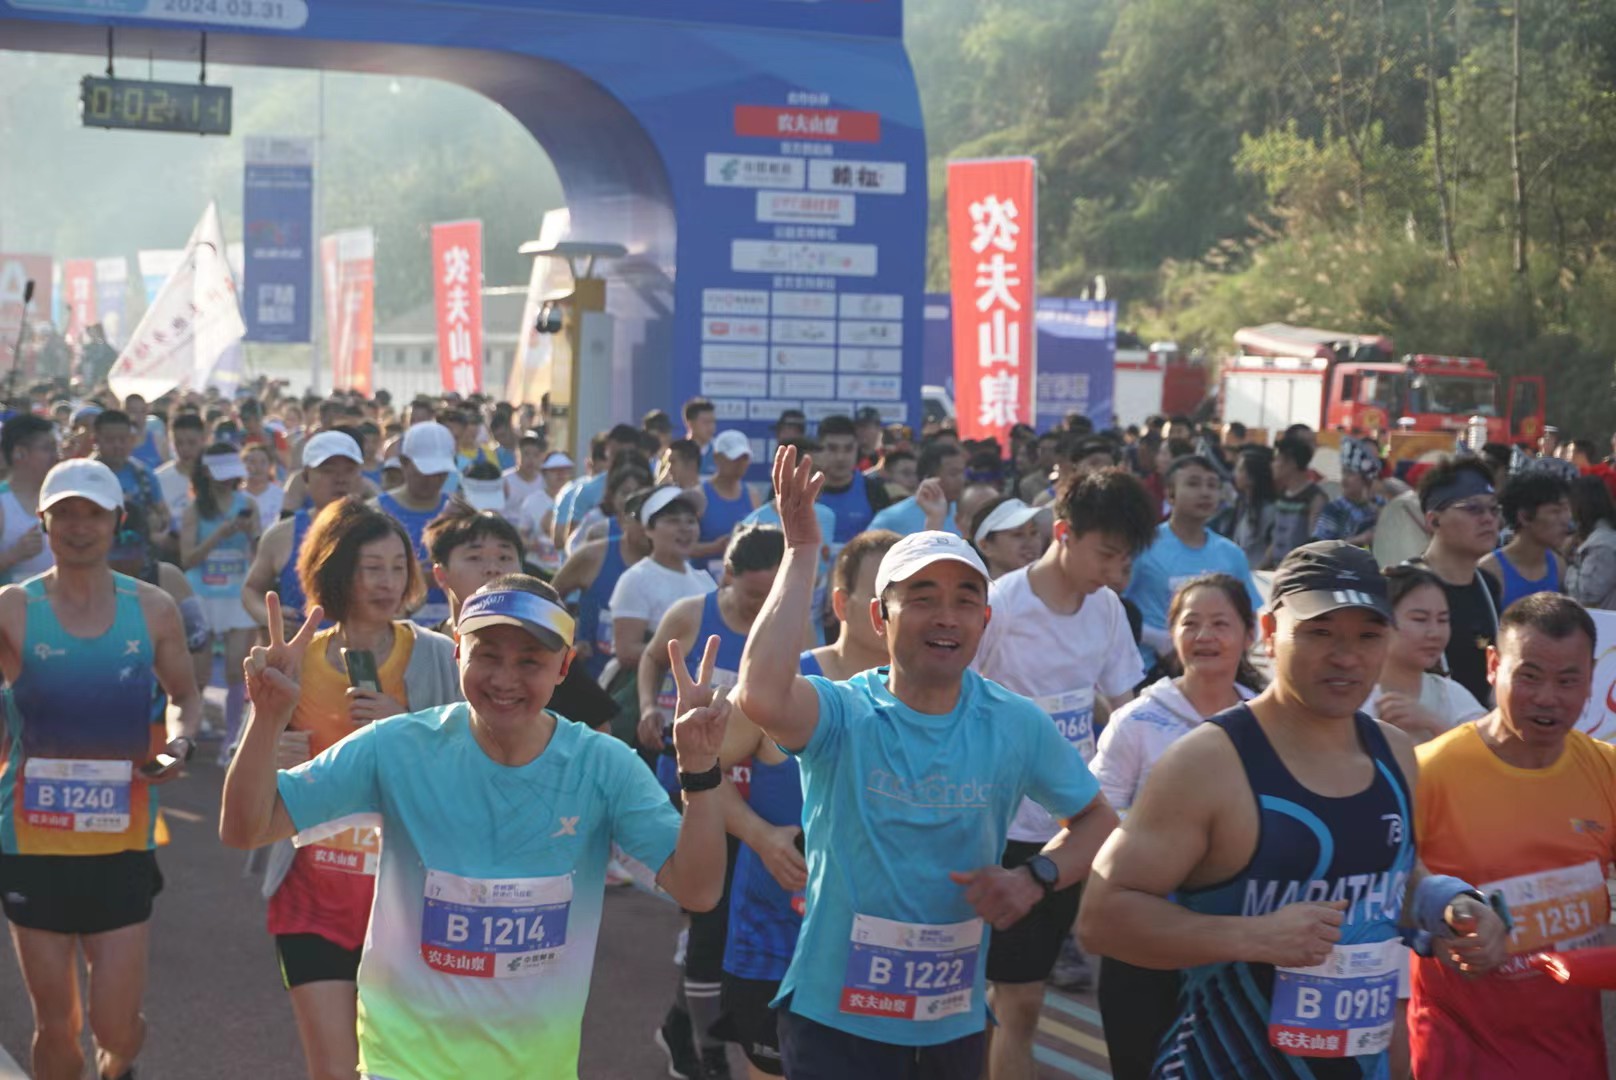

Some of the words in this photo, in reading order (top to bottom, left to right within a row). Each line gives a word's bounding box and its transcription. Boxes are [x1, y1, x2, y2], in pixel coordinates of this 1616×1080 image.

[163, 0, 284, 19] 2024.03.31
[968, 194, 1021, 427] 农夫山泉
[38, 785, 55, 807] B
[63, 786, 115, 809] 1240
[446, 914, 469, 943] B
[482, 915, 546, 946] 1214
[1535, 902, 1592, 938] 1251
[428, 950, 487, 972] 农夫山泉
[868, 955, 893, 985] B
[904, 958, 964, 989] 1222
[849, 993, 907, 1014] 农夫山泉
[1296, 987, 1322, 1019] B
[1335, 985, 1392, 1021] 0915
